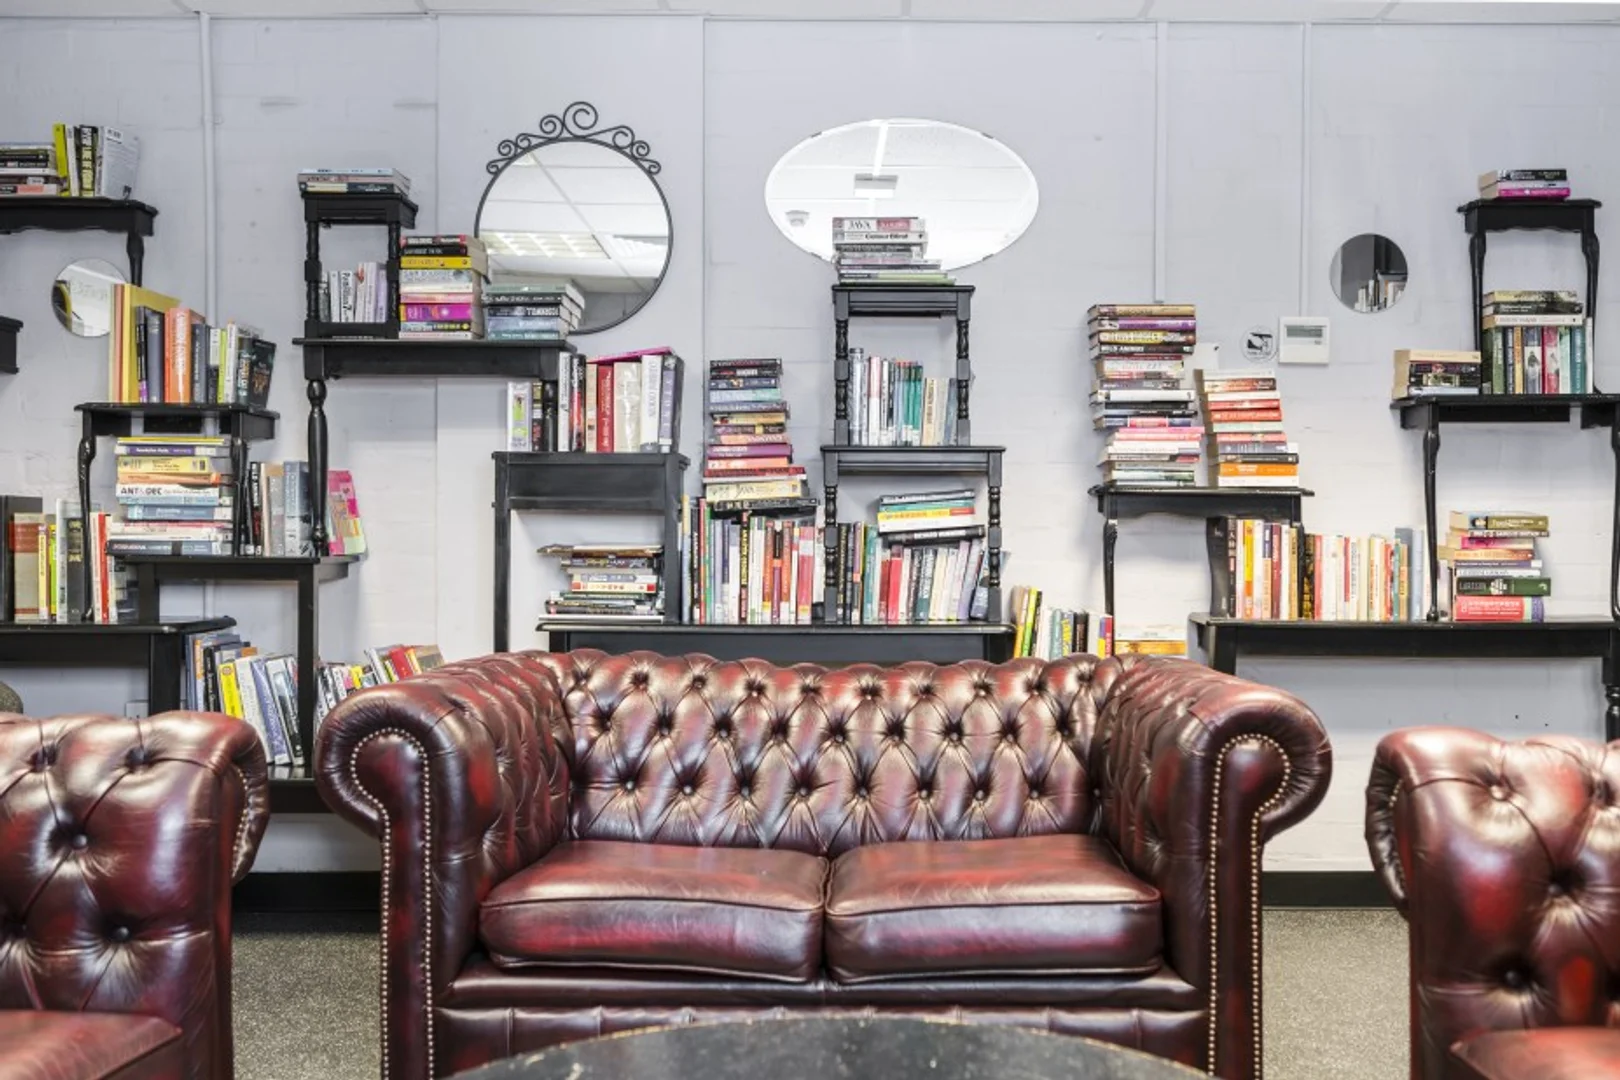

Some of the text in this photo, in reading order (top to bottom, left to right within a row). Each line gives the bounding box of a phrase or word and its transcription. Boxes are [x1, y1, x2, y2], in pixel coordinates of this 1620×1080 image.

[849, 220, 871, 230] JAVA
[121, 487, 139, 495] ANT
[146, 487, 162, 495] DEC
